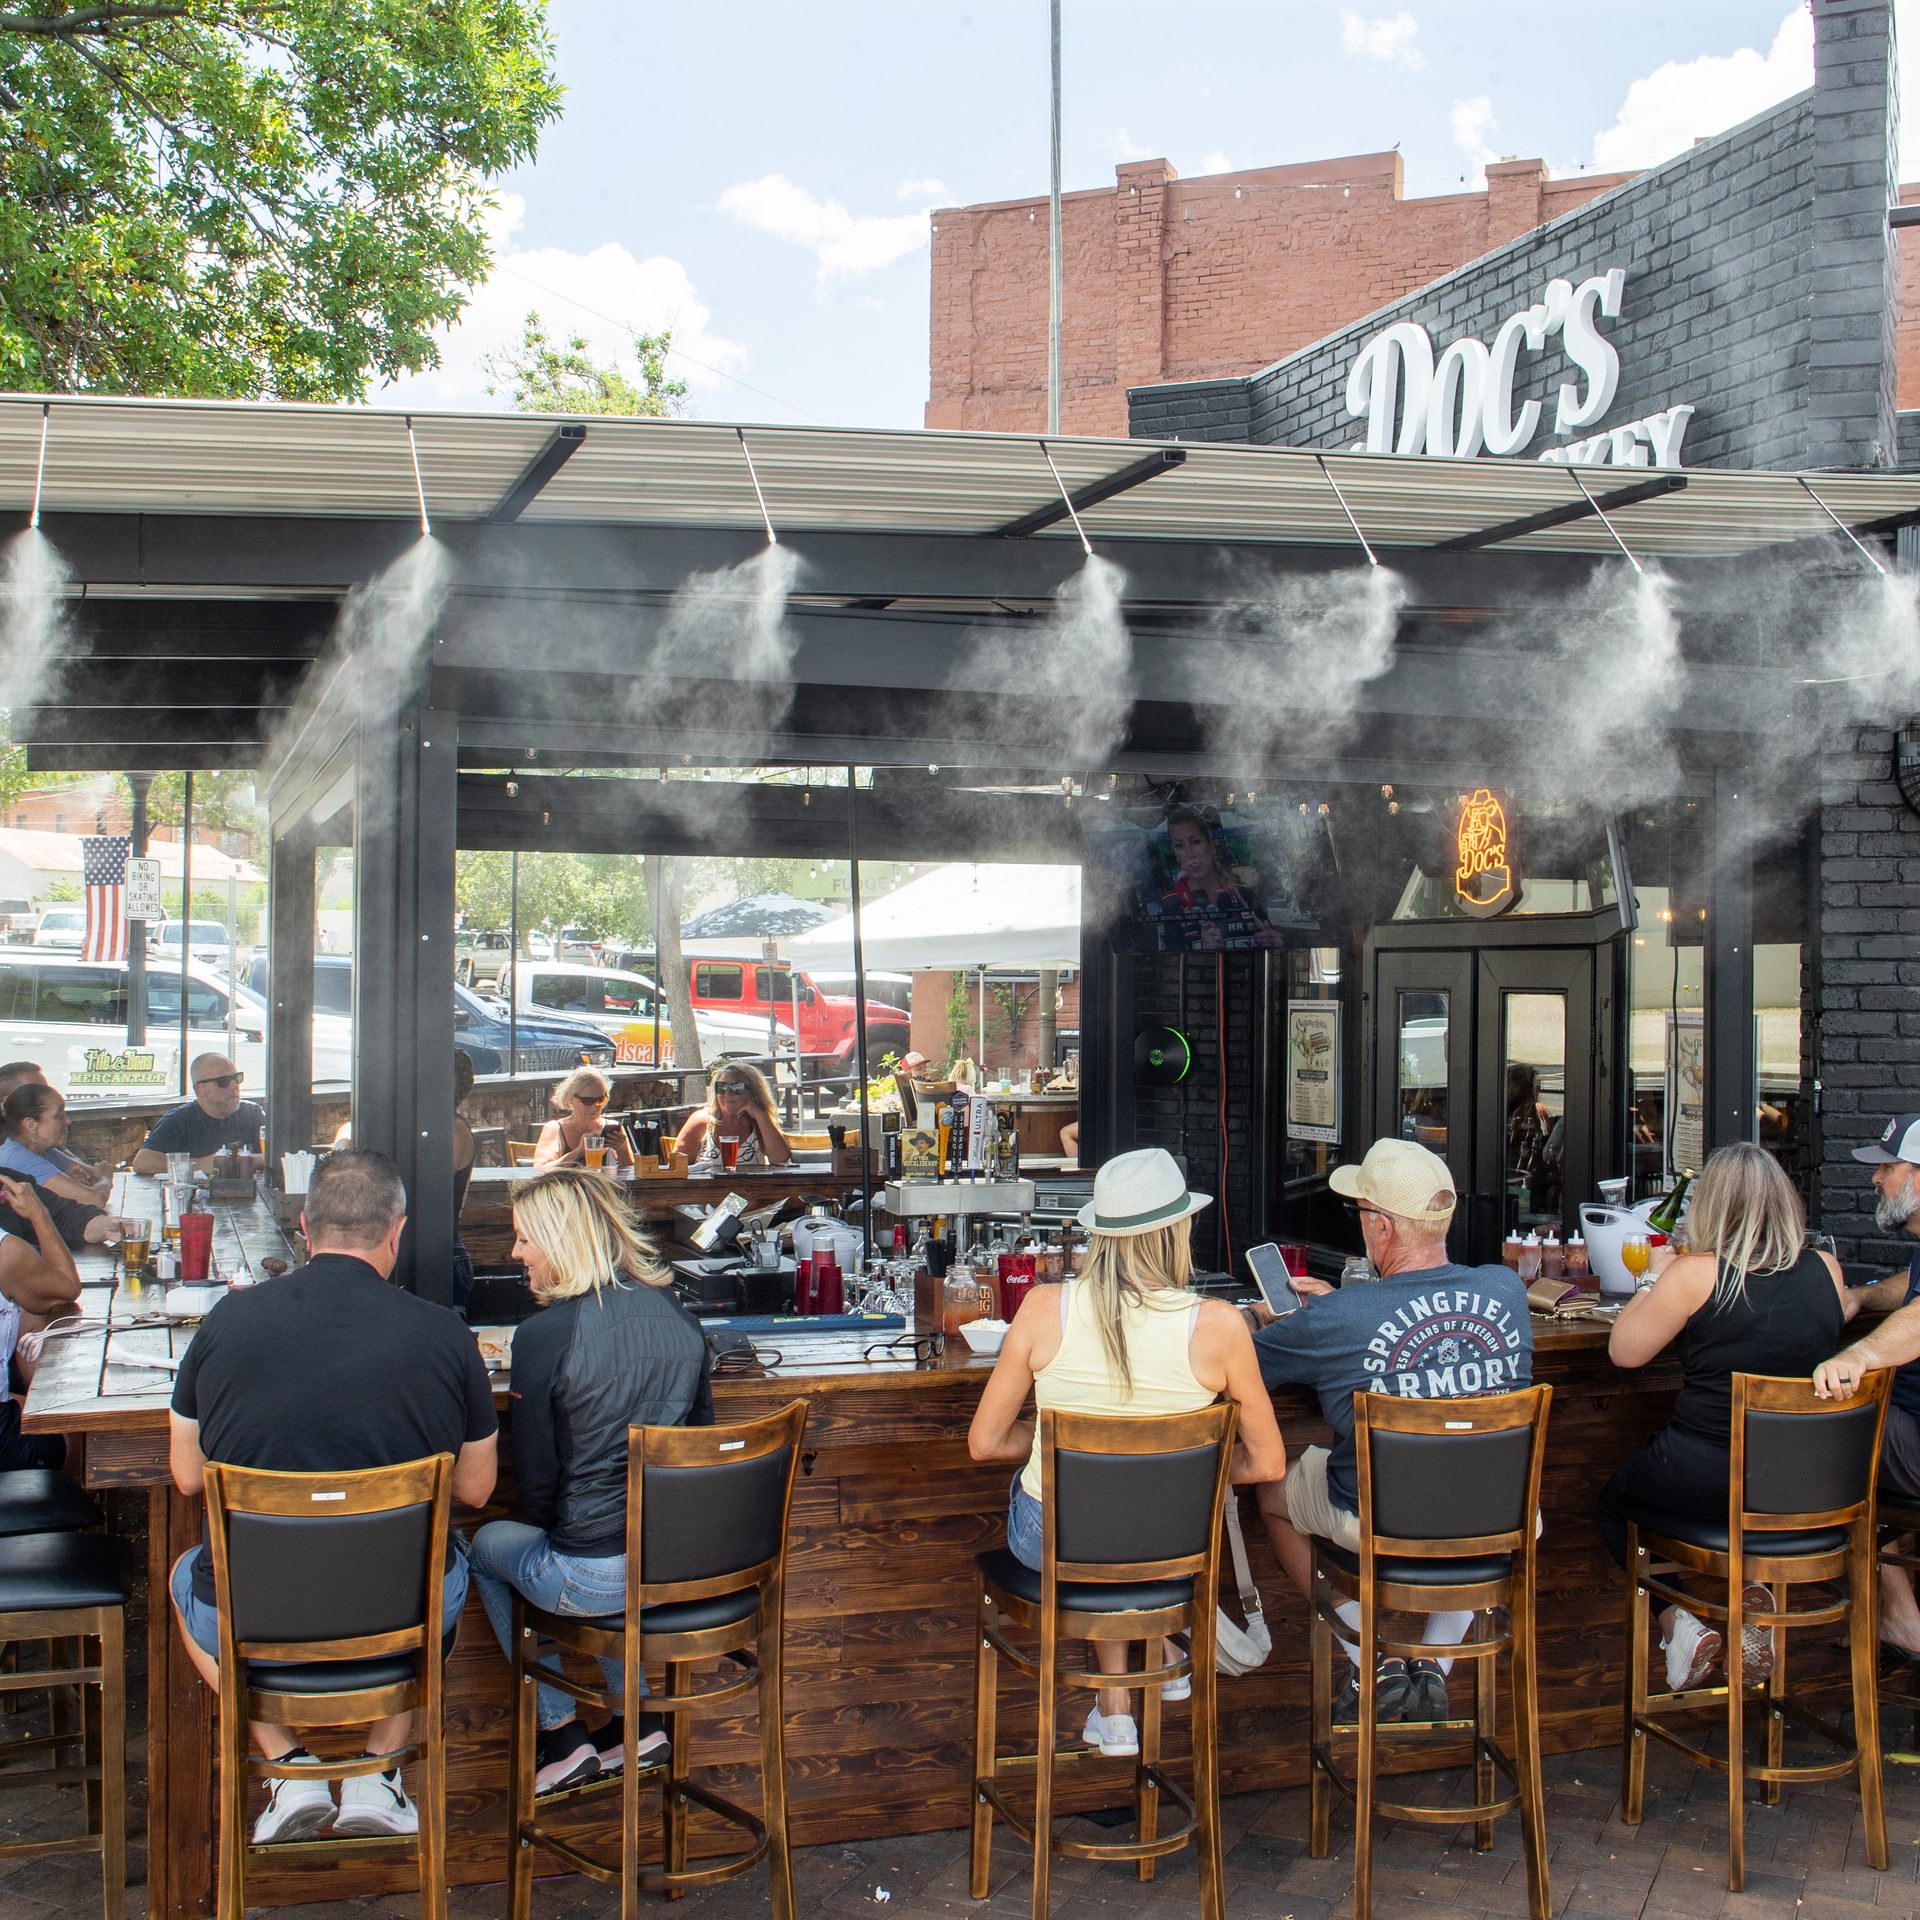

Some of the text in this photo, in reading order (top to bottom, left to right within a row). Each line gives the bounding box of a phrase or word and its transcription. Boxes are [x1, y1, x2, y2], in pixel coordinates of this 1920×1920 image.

[1346, 268, 1626, 457] DOC'S
[138, 861, 149, 872] NO
[1460, 843, 1506, 879] DOC'S
[131, 872, 155, 882] BIKING
[138, 882, 149, 892] OR
[127, 902, 159, 912] ALLOWED
[128, 892, 158, 903] SKATING
[71, 1072, 165, 1083] MERCANTILE
[974, 1103, 983, 1130] ULTRA
[1363, 1291, 1520, 1373] SPRINGFIELD
[1396, 1320, 1500, 1370] 250 YEARS OF FREEDOM
[1369, 1352, 1521, 1398] ARMORY
